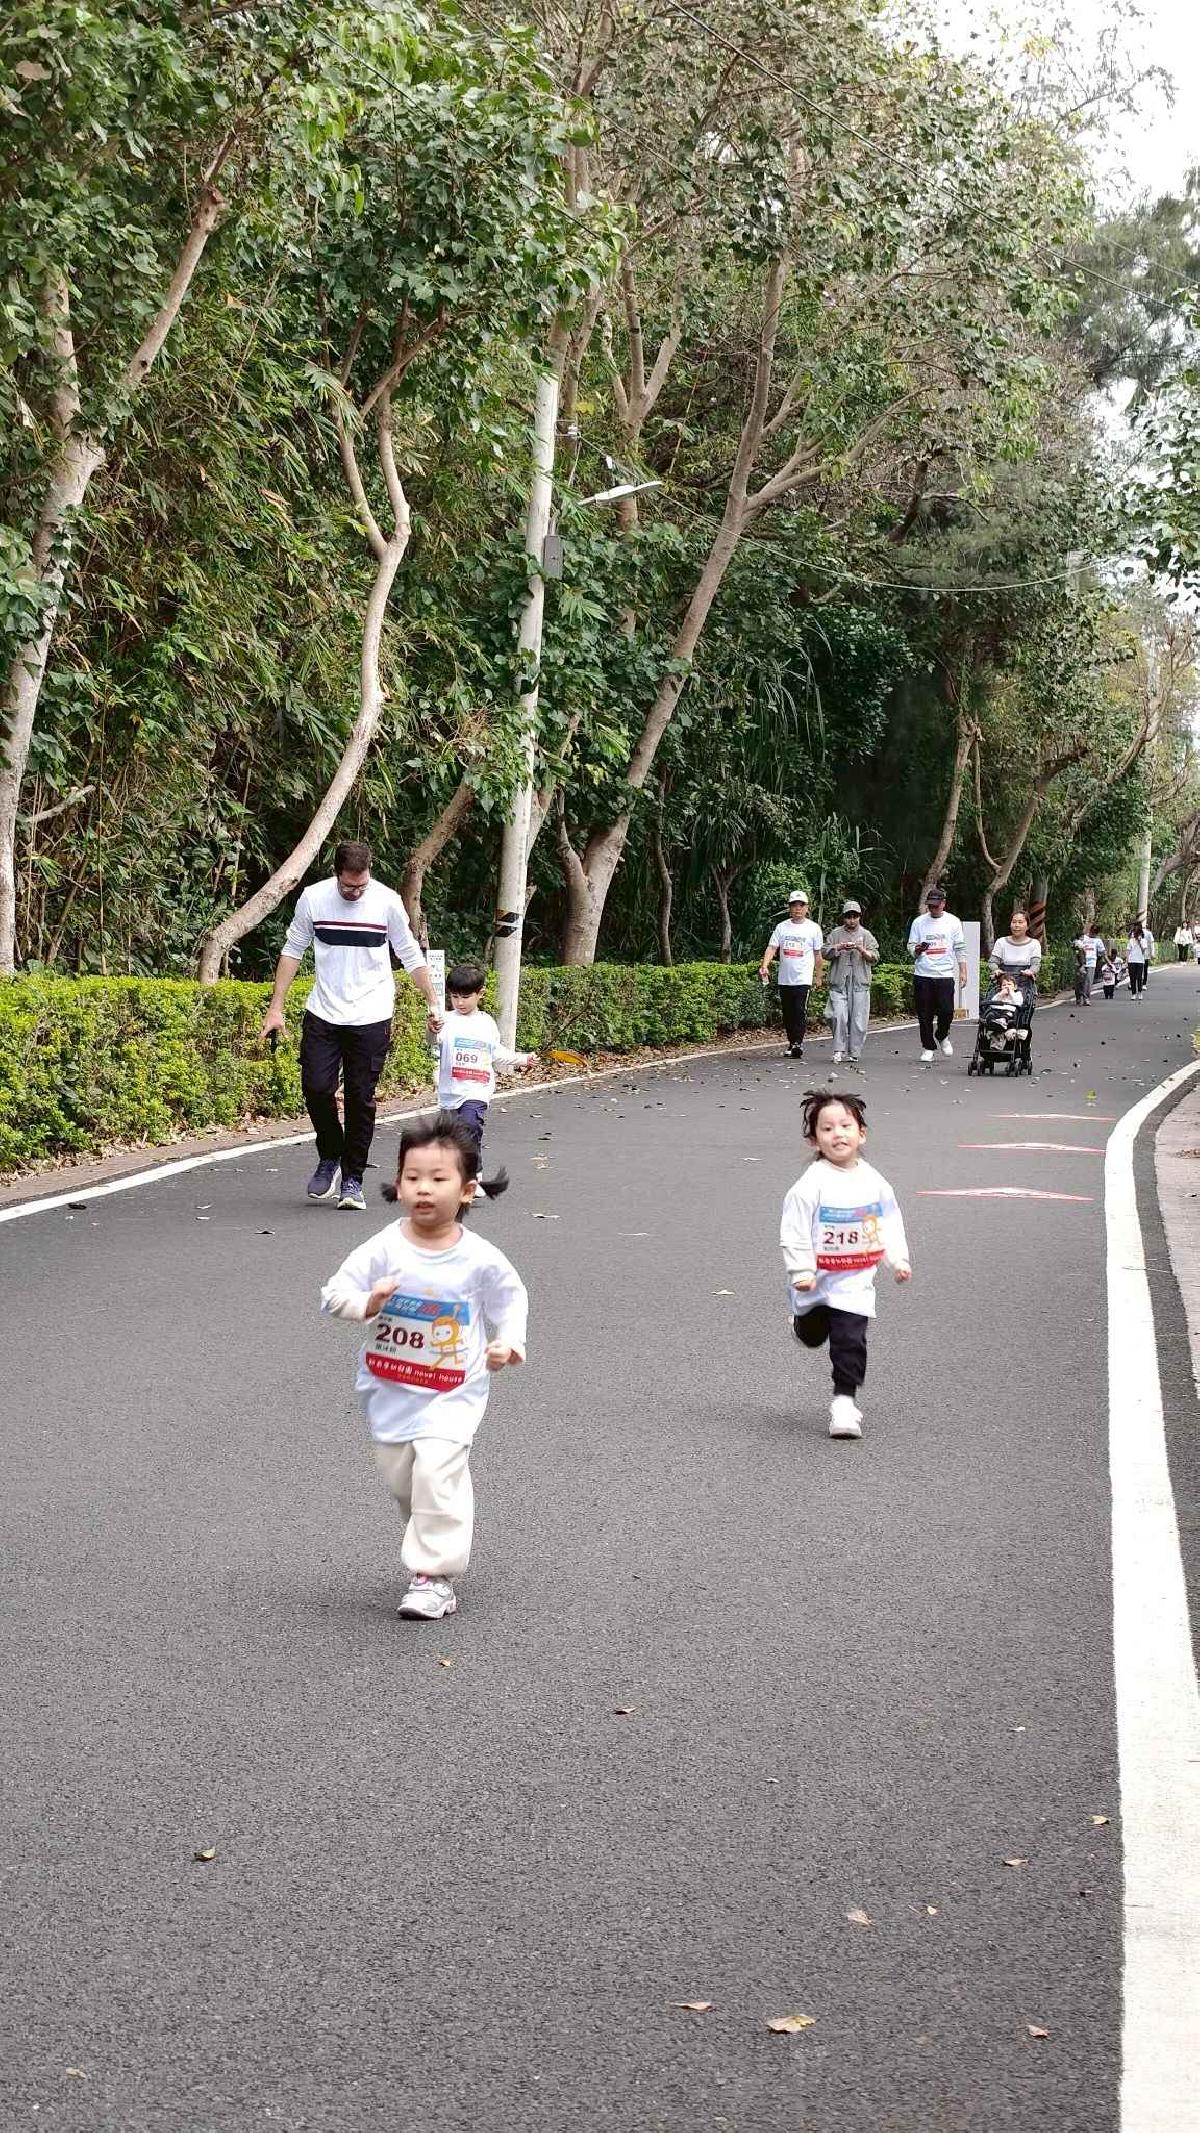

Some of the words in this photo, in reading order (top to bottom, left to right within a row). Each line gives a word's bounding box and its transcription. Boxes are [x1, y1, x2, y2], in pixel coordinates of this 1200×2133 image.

[456, 1053, 478, 1063] 069
[824, 1232, 858, 1244] 218
[375, 1323, 424, 1349] 208
